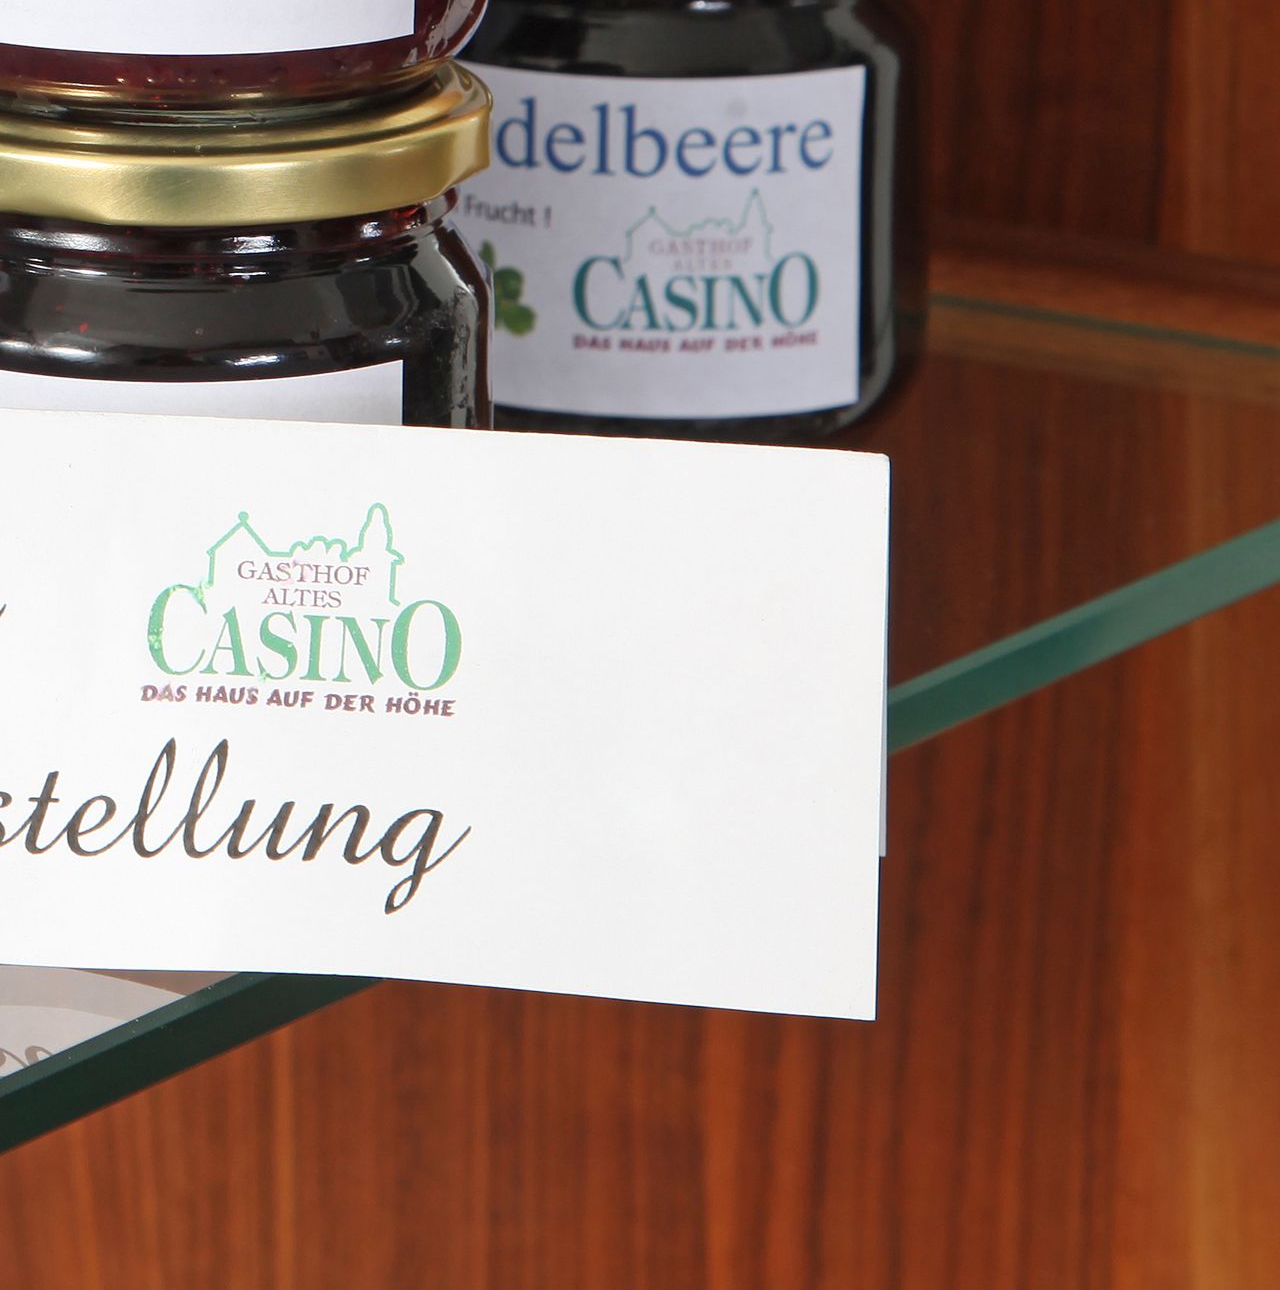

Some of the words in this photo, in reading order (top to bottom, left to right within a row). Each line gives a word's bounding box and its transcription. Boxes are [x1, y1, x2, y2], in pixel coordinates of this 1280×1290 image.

[496, 97, 834, 178] delbeere
[572, 251, 819, 332] CASINO
[236, 557, 371, 588] GASTHOF
[263, 586, 343, 609] ALTES
[147, 583, 462, 691] CASINO
[140, 683, 187, 705] DAS
[196, 685, 258, 707] HAUS
[266, 690, 314, 711] AUF
[325, 692, 376, 716] DER
[385, 689, 457, 718] HÖHE
